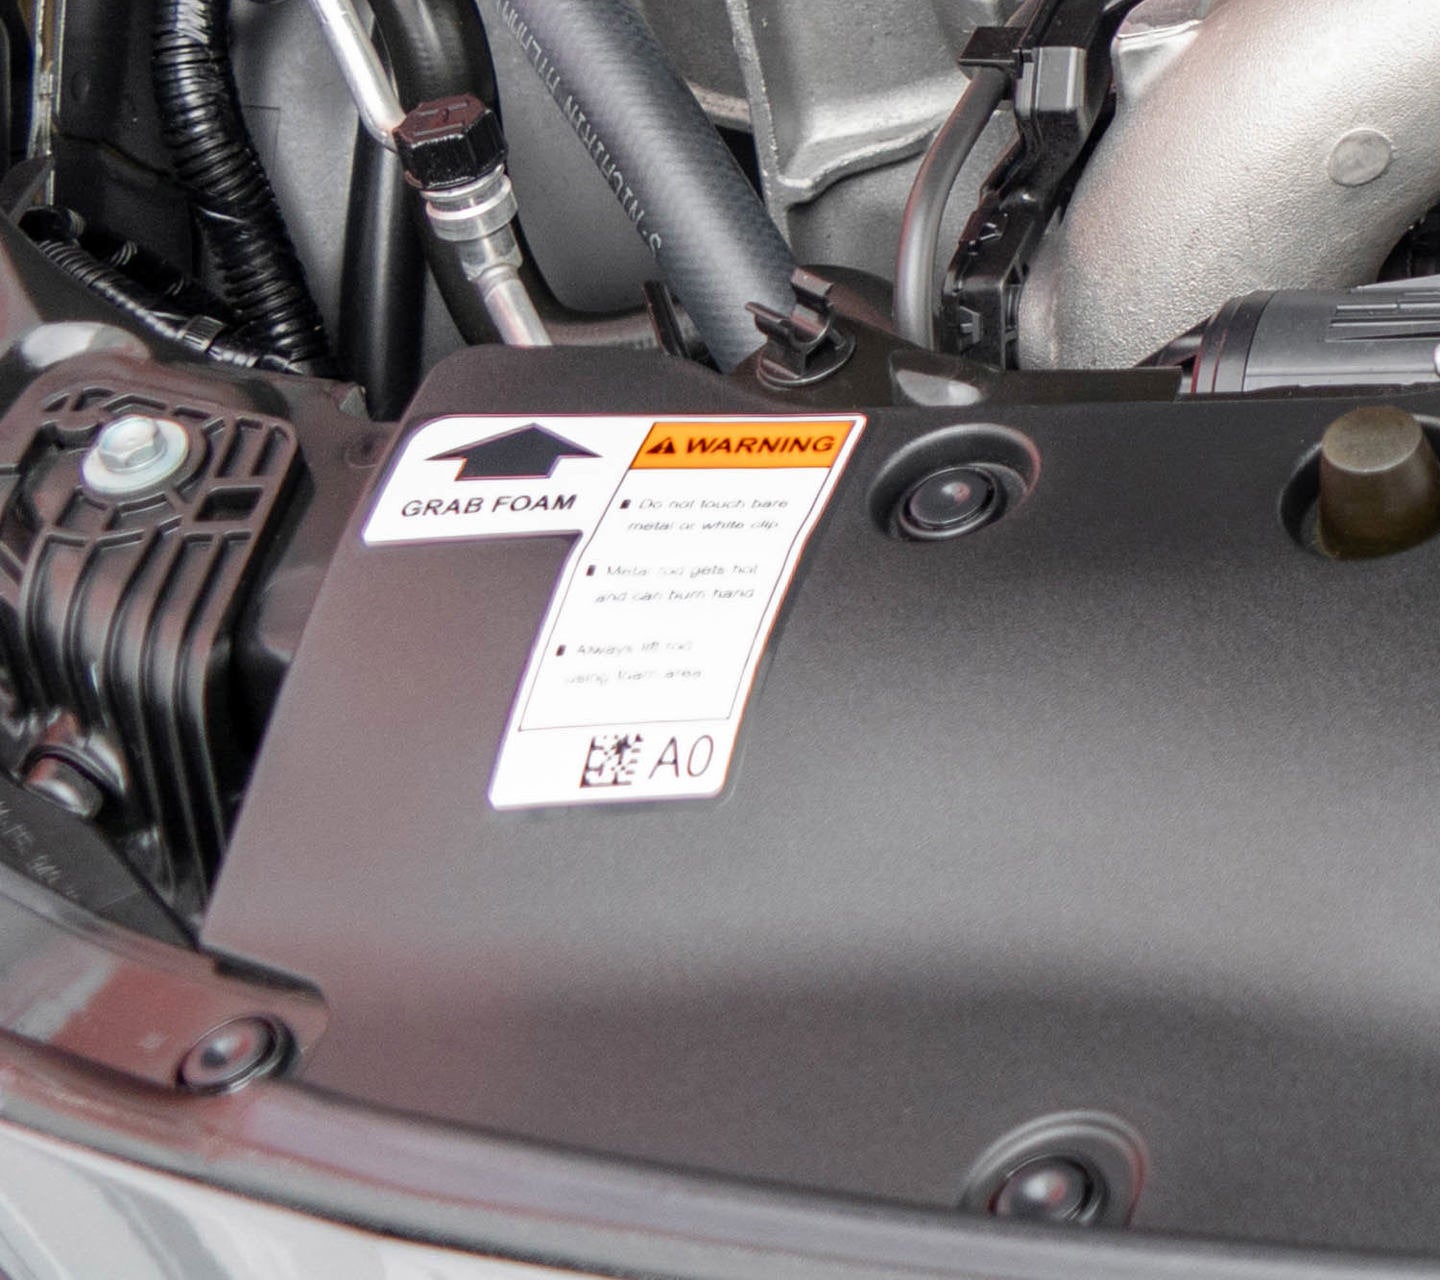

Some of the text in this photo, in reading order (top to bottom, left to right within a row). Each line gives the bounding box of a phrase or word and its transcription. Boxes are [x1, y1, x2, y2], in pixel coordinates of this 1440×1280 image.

[685, 435, 835, 455] WARNING
[400, 494, 578, 517] GRAB FOAM
[700, 497, 745, 508] touch
[649, 734, 715, 780] A0
